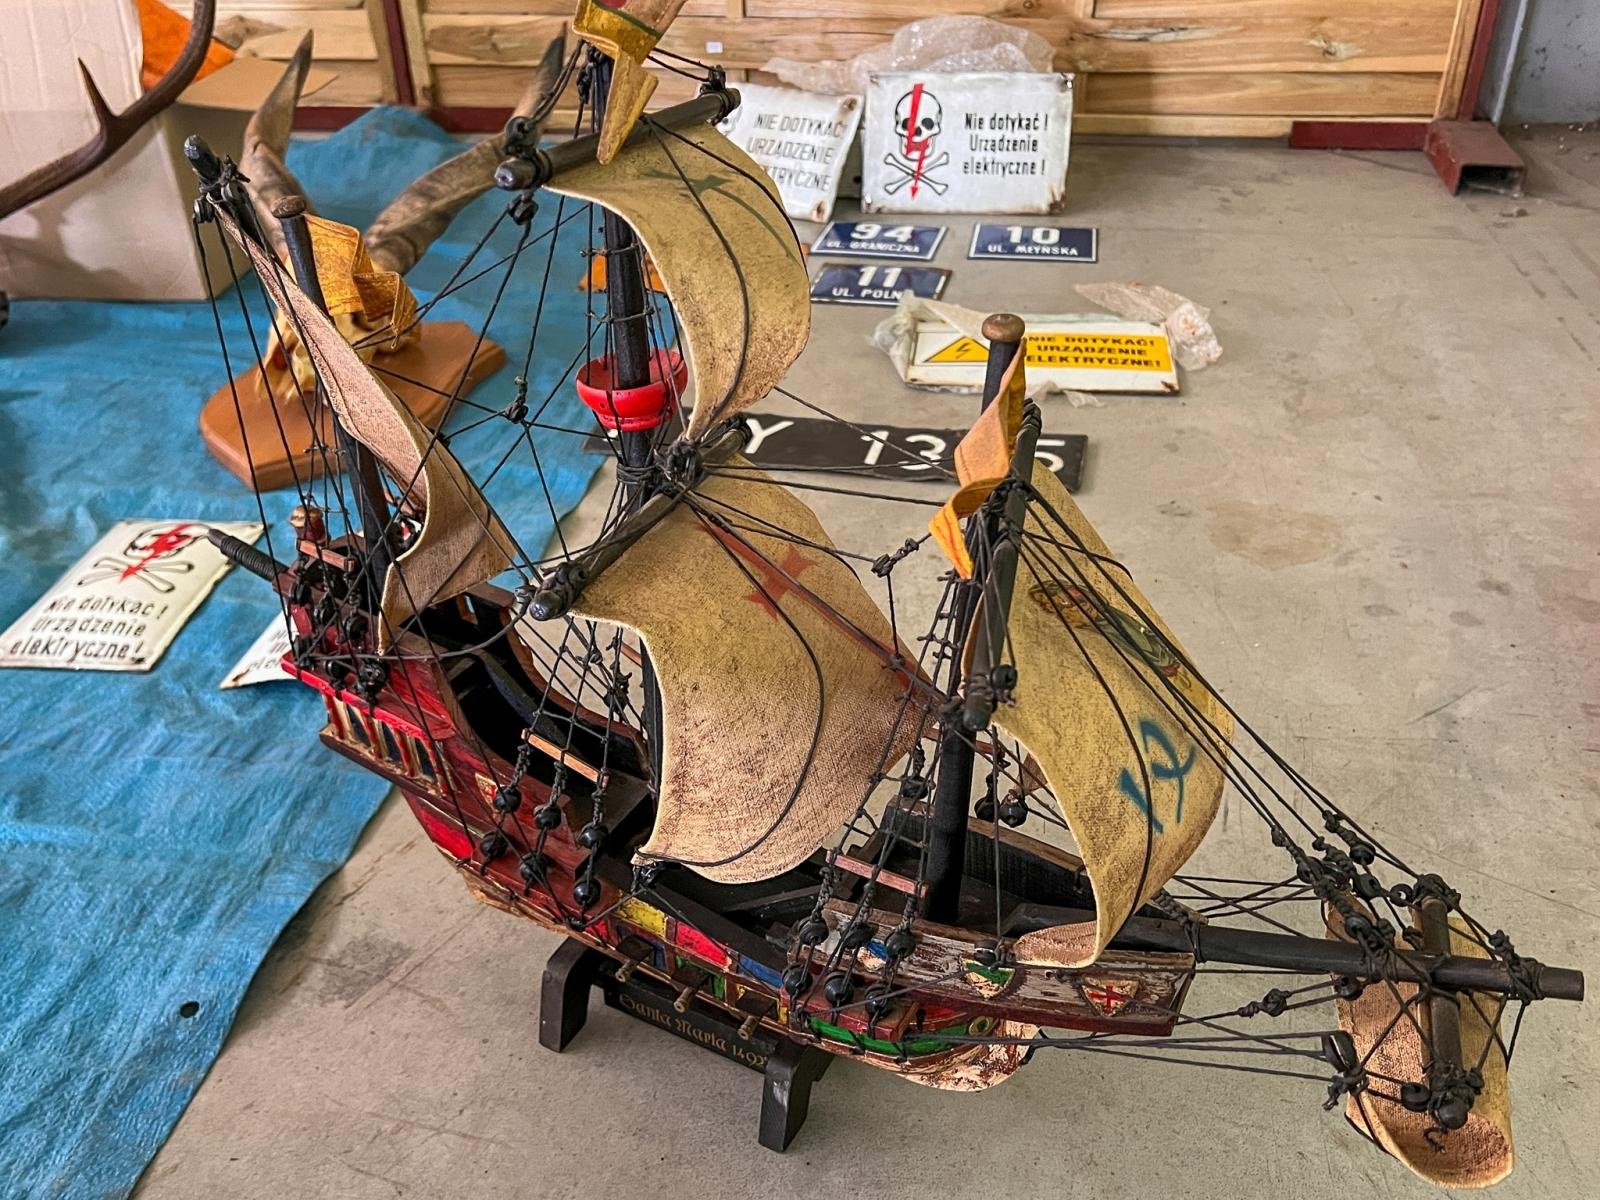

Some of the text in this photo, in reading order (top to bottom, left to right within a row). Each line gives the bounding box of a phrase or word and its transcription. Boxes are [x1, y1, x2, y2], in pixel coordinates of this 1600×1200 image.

[753, 114, 777, 130] NIE
[964, 112, 984, 130] Nie
[969, 134, 1038, 154] Urządzenie
[767, 165, 832, 192] TRYCZNE
[850, 223, 915, 243] 94
[1006, 226, 1060, 245] 10
[849, 240, 920, 253] GRANICZNA
[1014, 244, 1079, 256] MŁYŃSKA
[858, 265, 903, 288] 11
[860, 288, 903, 300] POLN
[1028, 335, 1056, 343] NIE
[1036, 344, 1149, 356] URZĄDZENIE
[1026, 354, 1162, 368] ELEKTRYCZNE!
[860, 429, 1066, 473] 135
